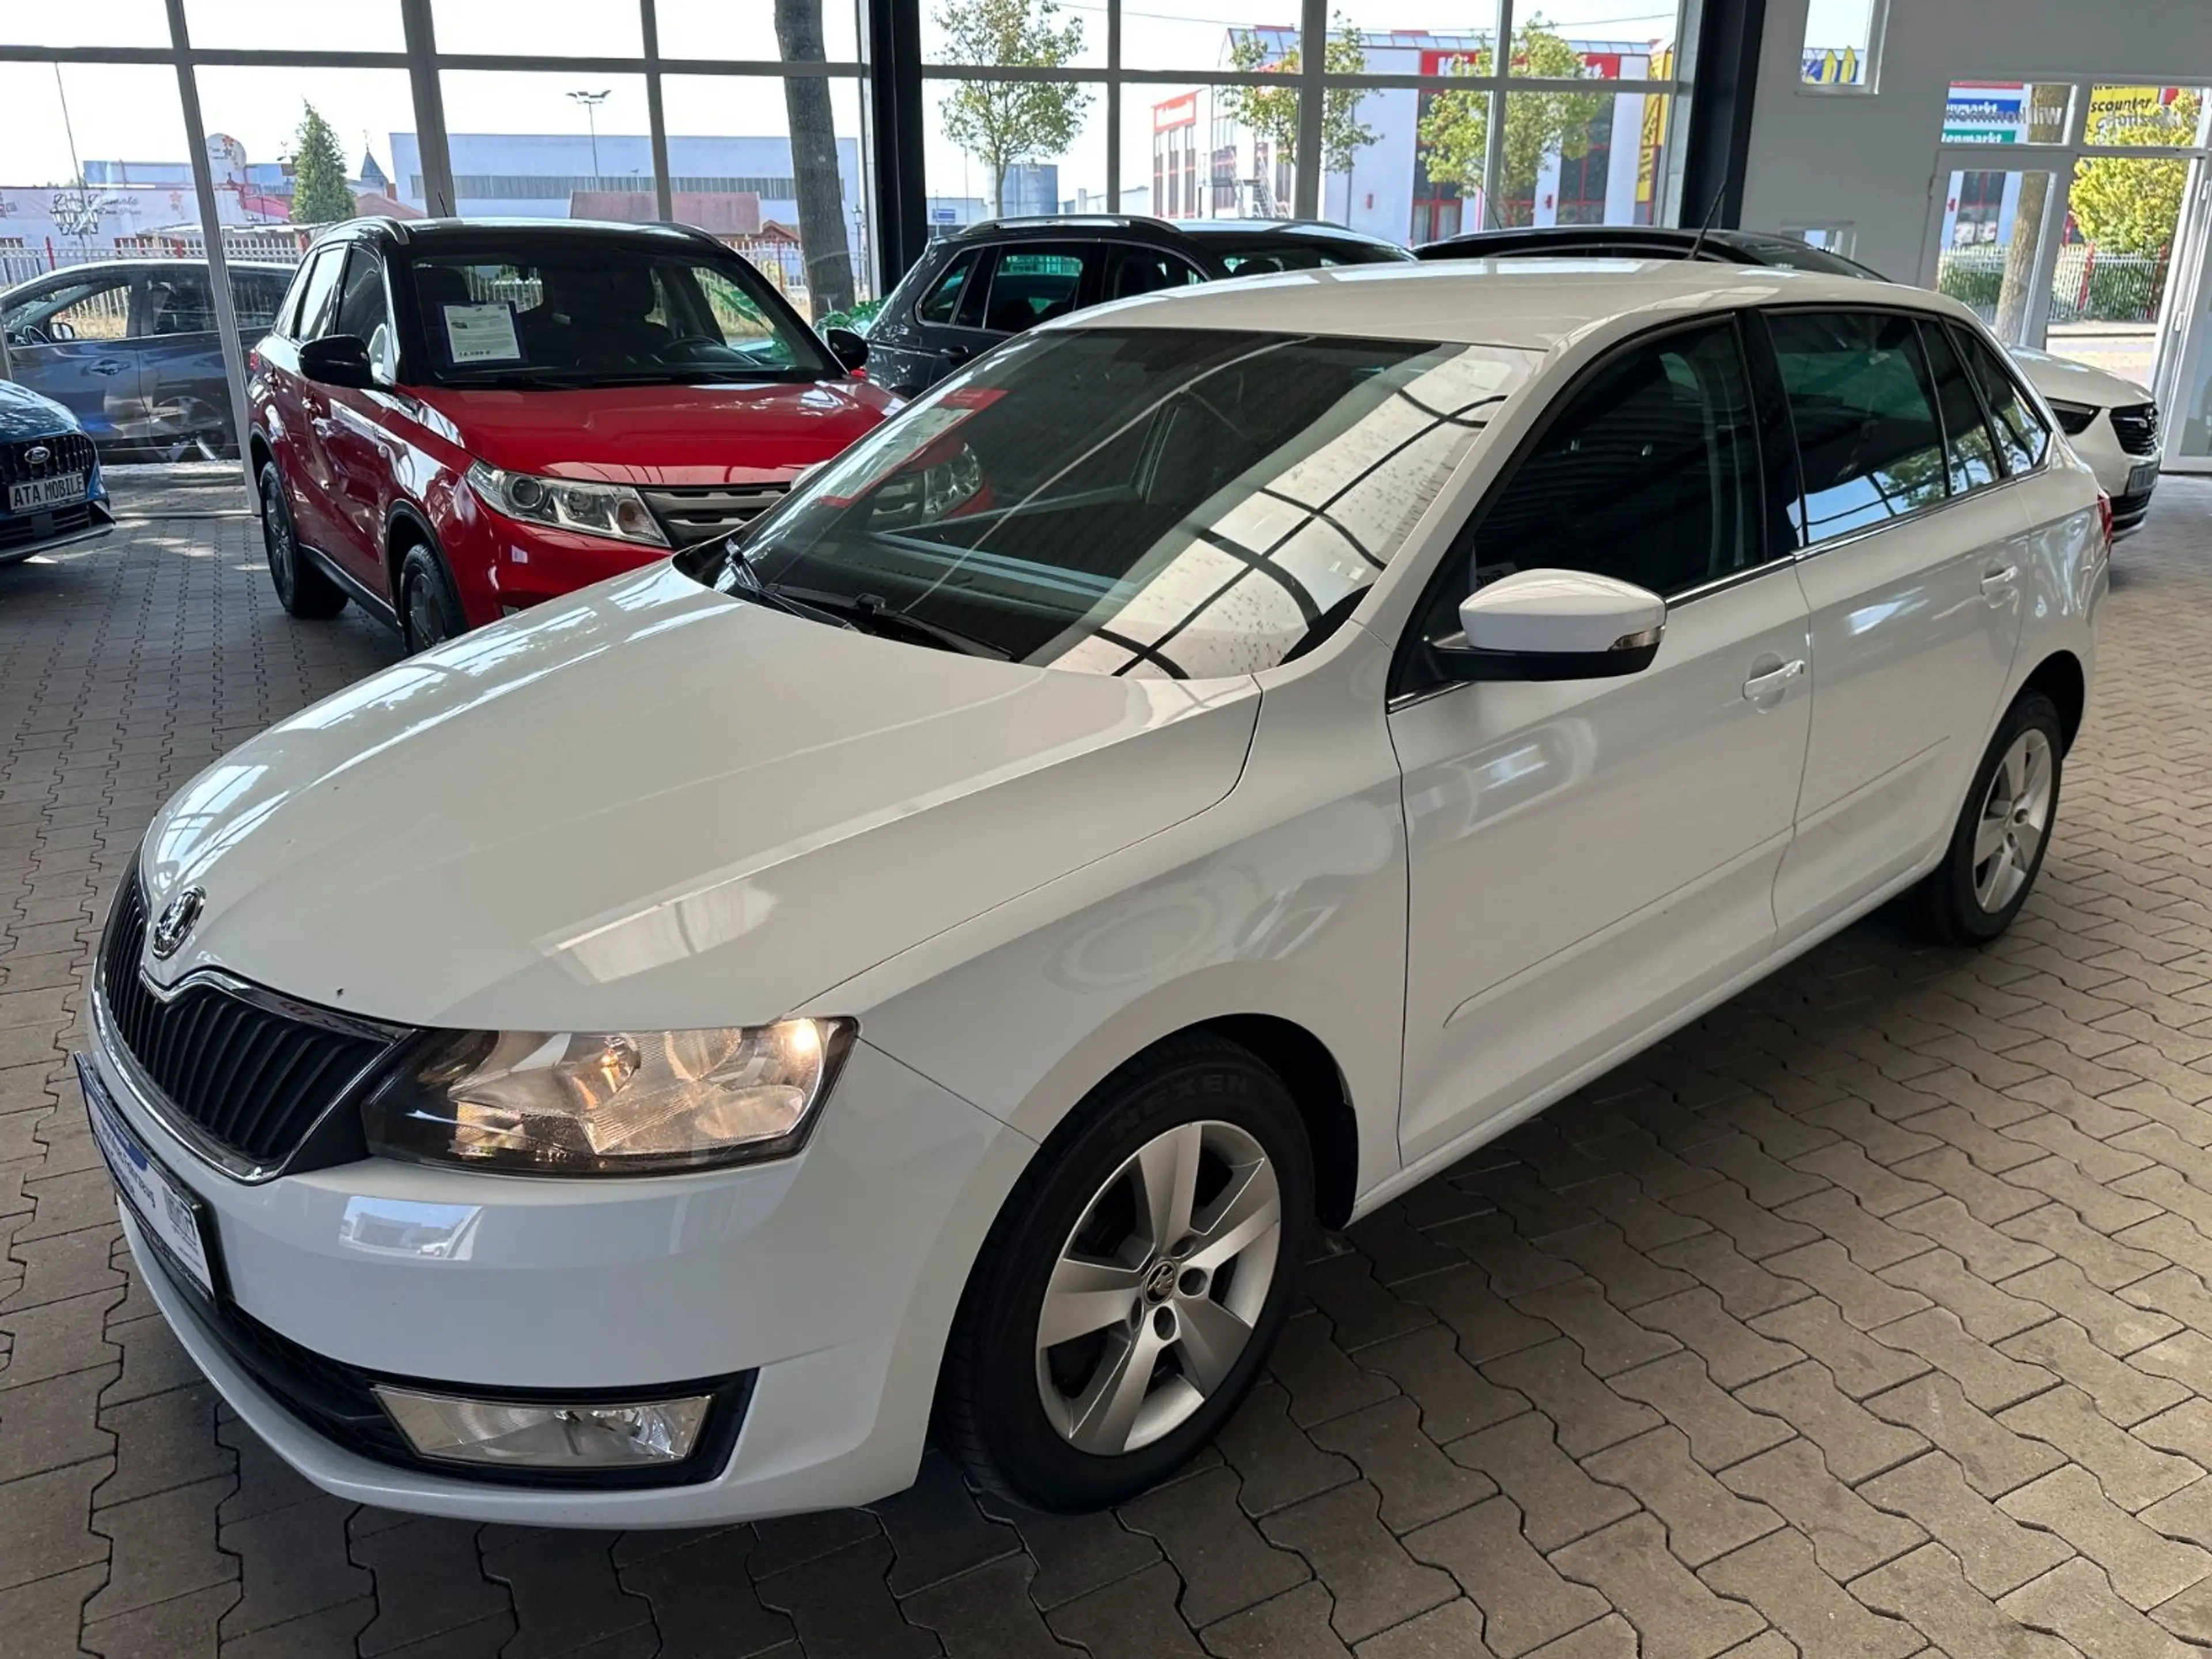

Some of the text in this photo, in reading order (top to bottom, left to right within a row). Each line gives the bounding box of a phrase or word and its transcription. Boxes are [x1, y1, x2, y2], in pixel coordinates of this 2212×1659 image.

[14, 476, 84, 506] ATA MOBILE
[1109, 1074, 1249, 1142] NEXEN
